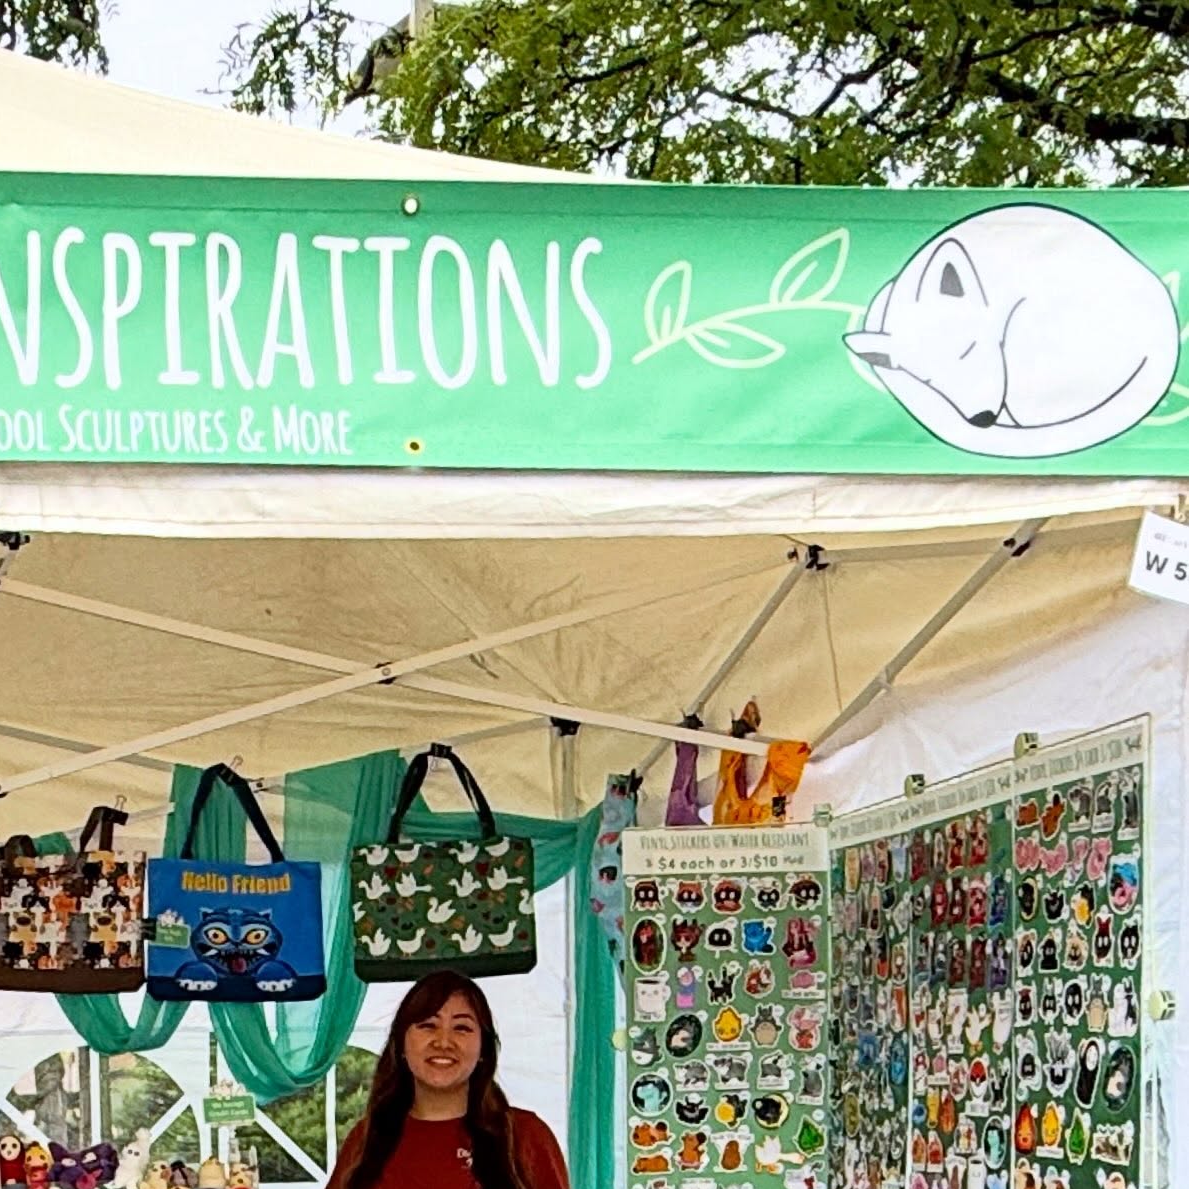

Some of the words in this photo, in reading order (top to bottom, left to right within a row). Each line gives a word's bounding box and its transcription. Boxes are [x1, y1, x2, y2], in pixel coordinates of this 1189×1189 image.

[58, 404, 228, 454] SCULPTURES
[236, 405, 267, 453] &
[272, 404, 353, 456] MORE
[1146, 550, 1169, 574] W
[658, 856, 675, 871] $4
[680, 855, 714, 870] each
[719, 858, 737, 869] or
[181, 871, 228, 893] Hello
[231, 873, 291, 894] Friend
